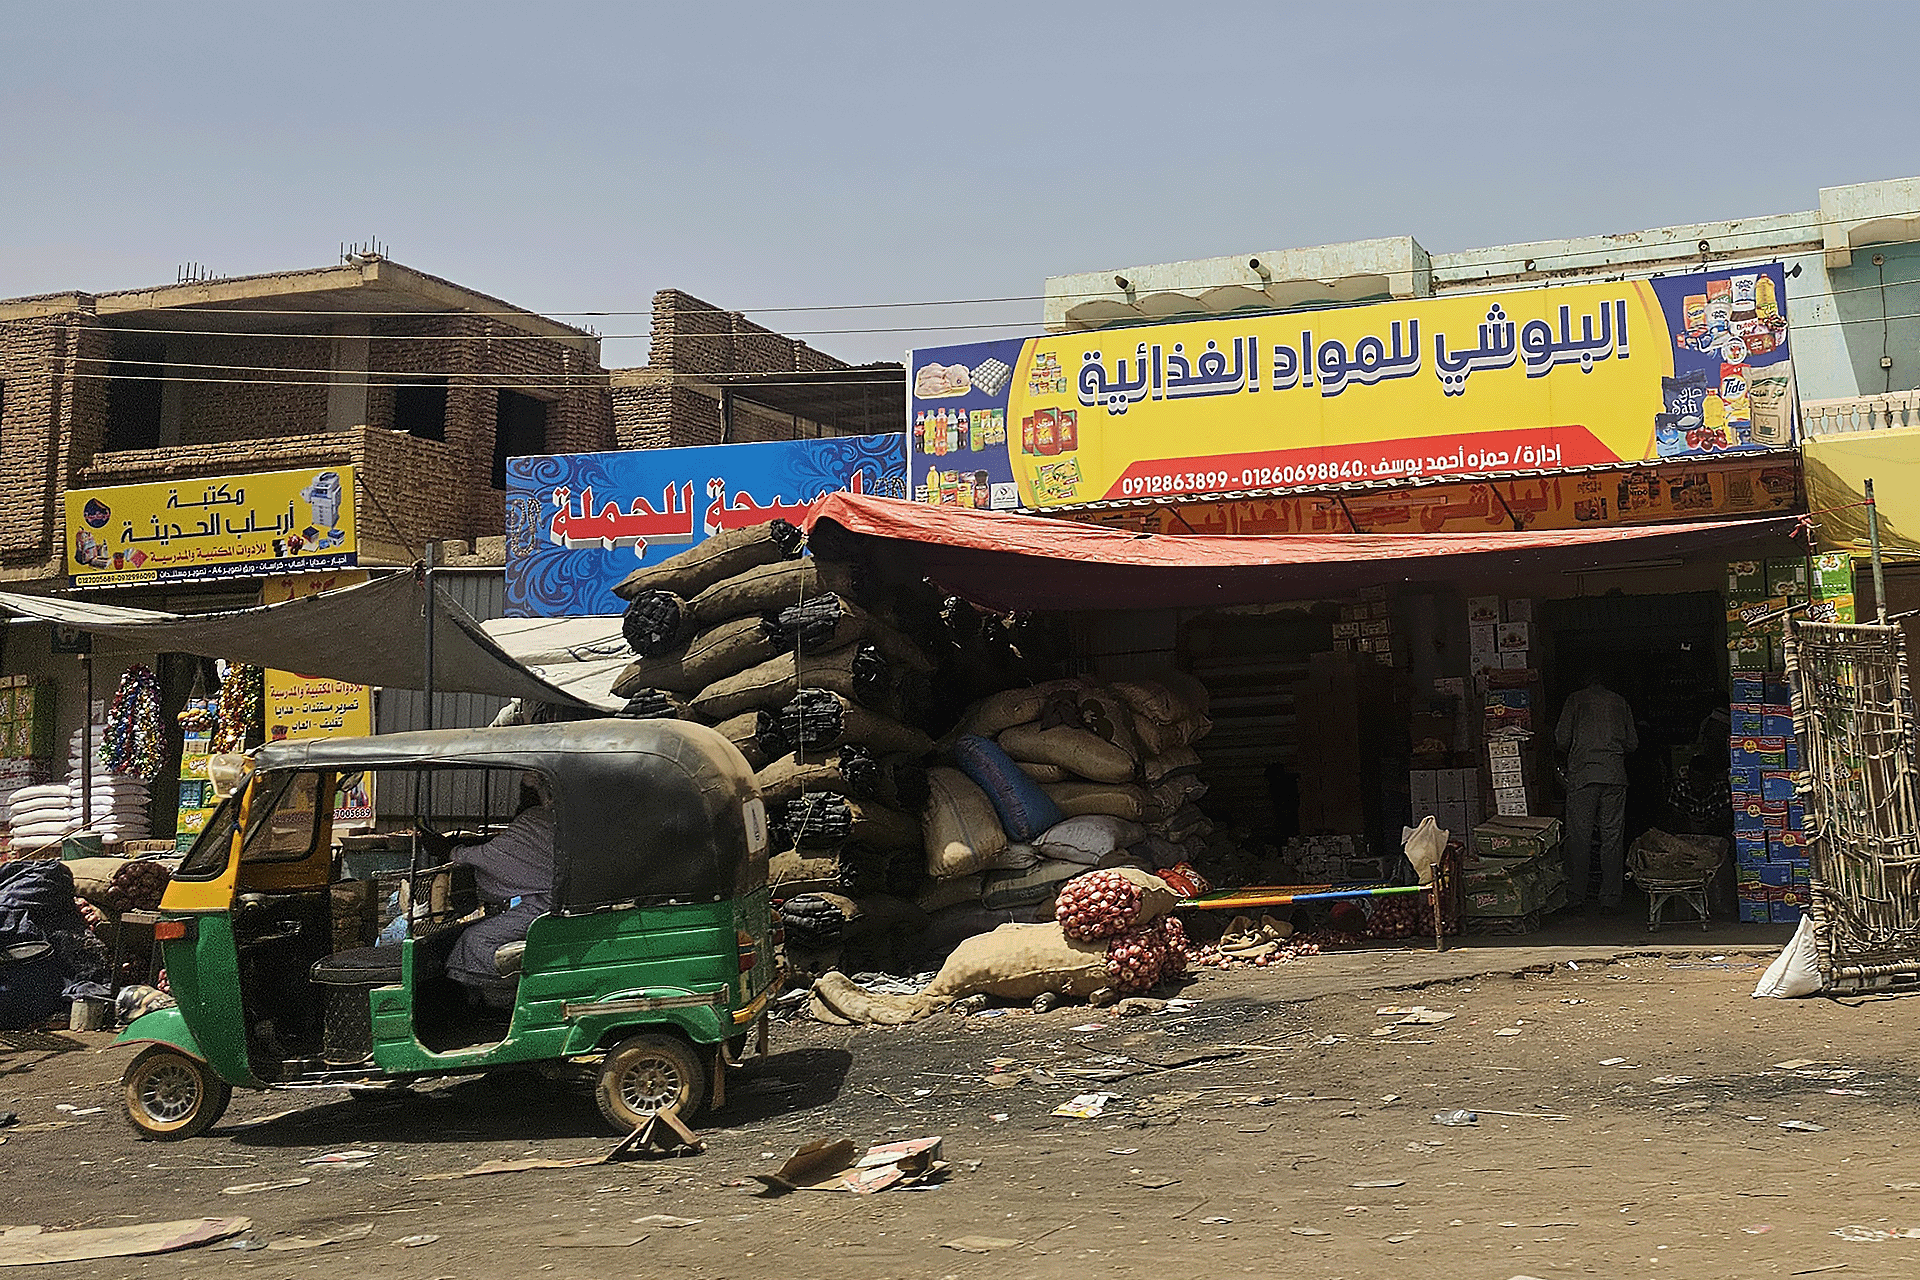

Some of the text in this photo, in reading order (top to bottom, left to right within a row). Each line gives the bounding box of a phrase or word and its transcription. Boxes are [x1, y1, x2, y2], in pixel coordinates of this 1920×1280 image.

[1078, 300, 1630, 415] البلوشي للمواد الغذائية
[1723, 378, 1746, 397] Tide
[1671, 399, 1698, 415] Safi
[1426, 446, 1464, 471] أحمد
[1122, 470, 1228, 495] 0912863899
[1242, 460, 1363, 486] 01260698840
[166, 483, 245, 511] مكتبة
[120, 500, 295, 546] أرباب الحديثة
[550, 479, 695, 560] للجملة
[275, 706, 294, 718] هدايا
[302, 702, 333, 713] مستندات
[334, 699, 358, 714] تصوير
[333, 808, 371, 819] 7005689
